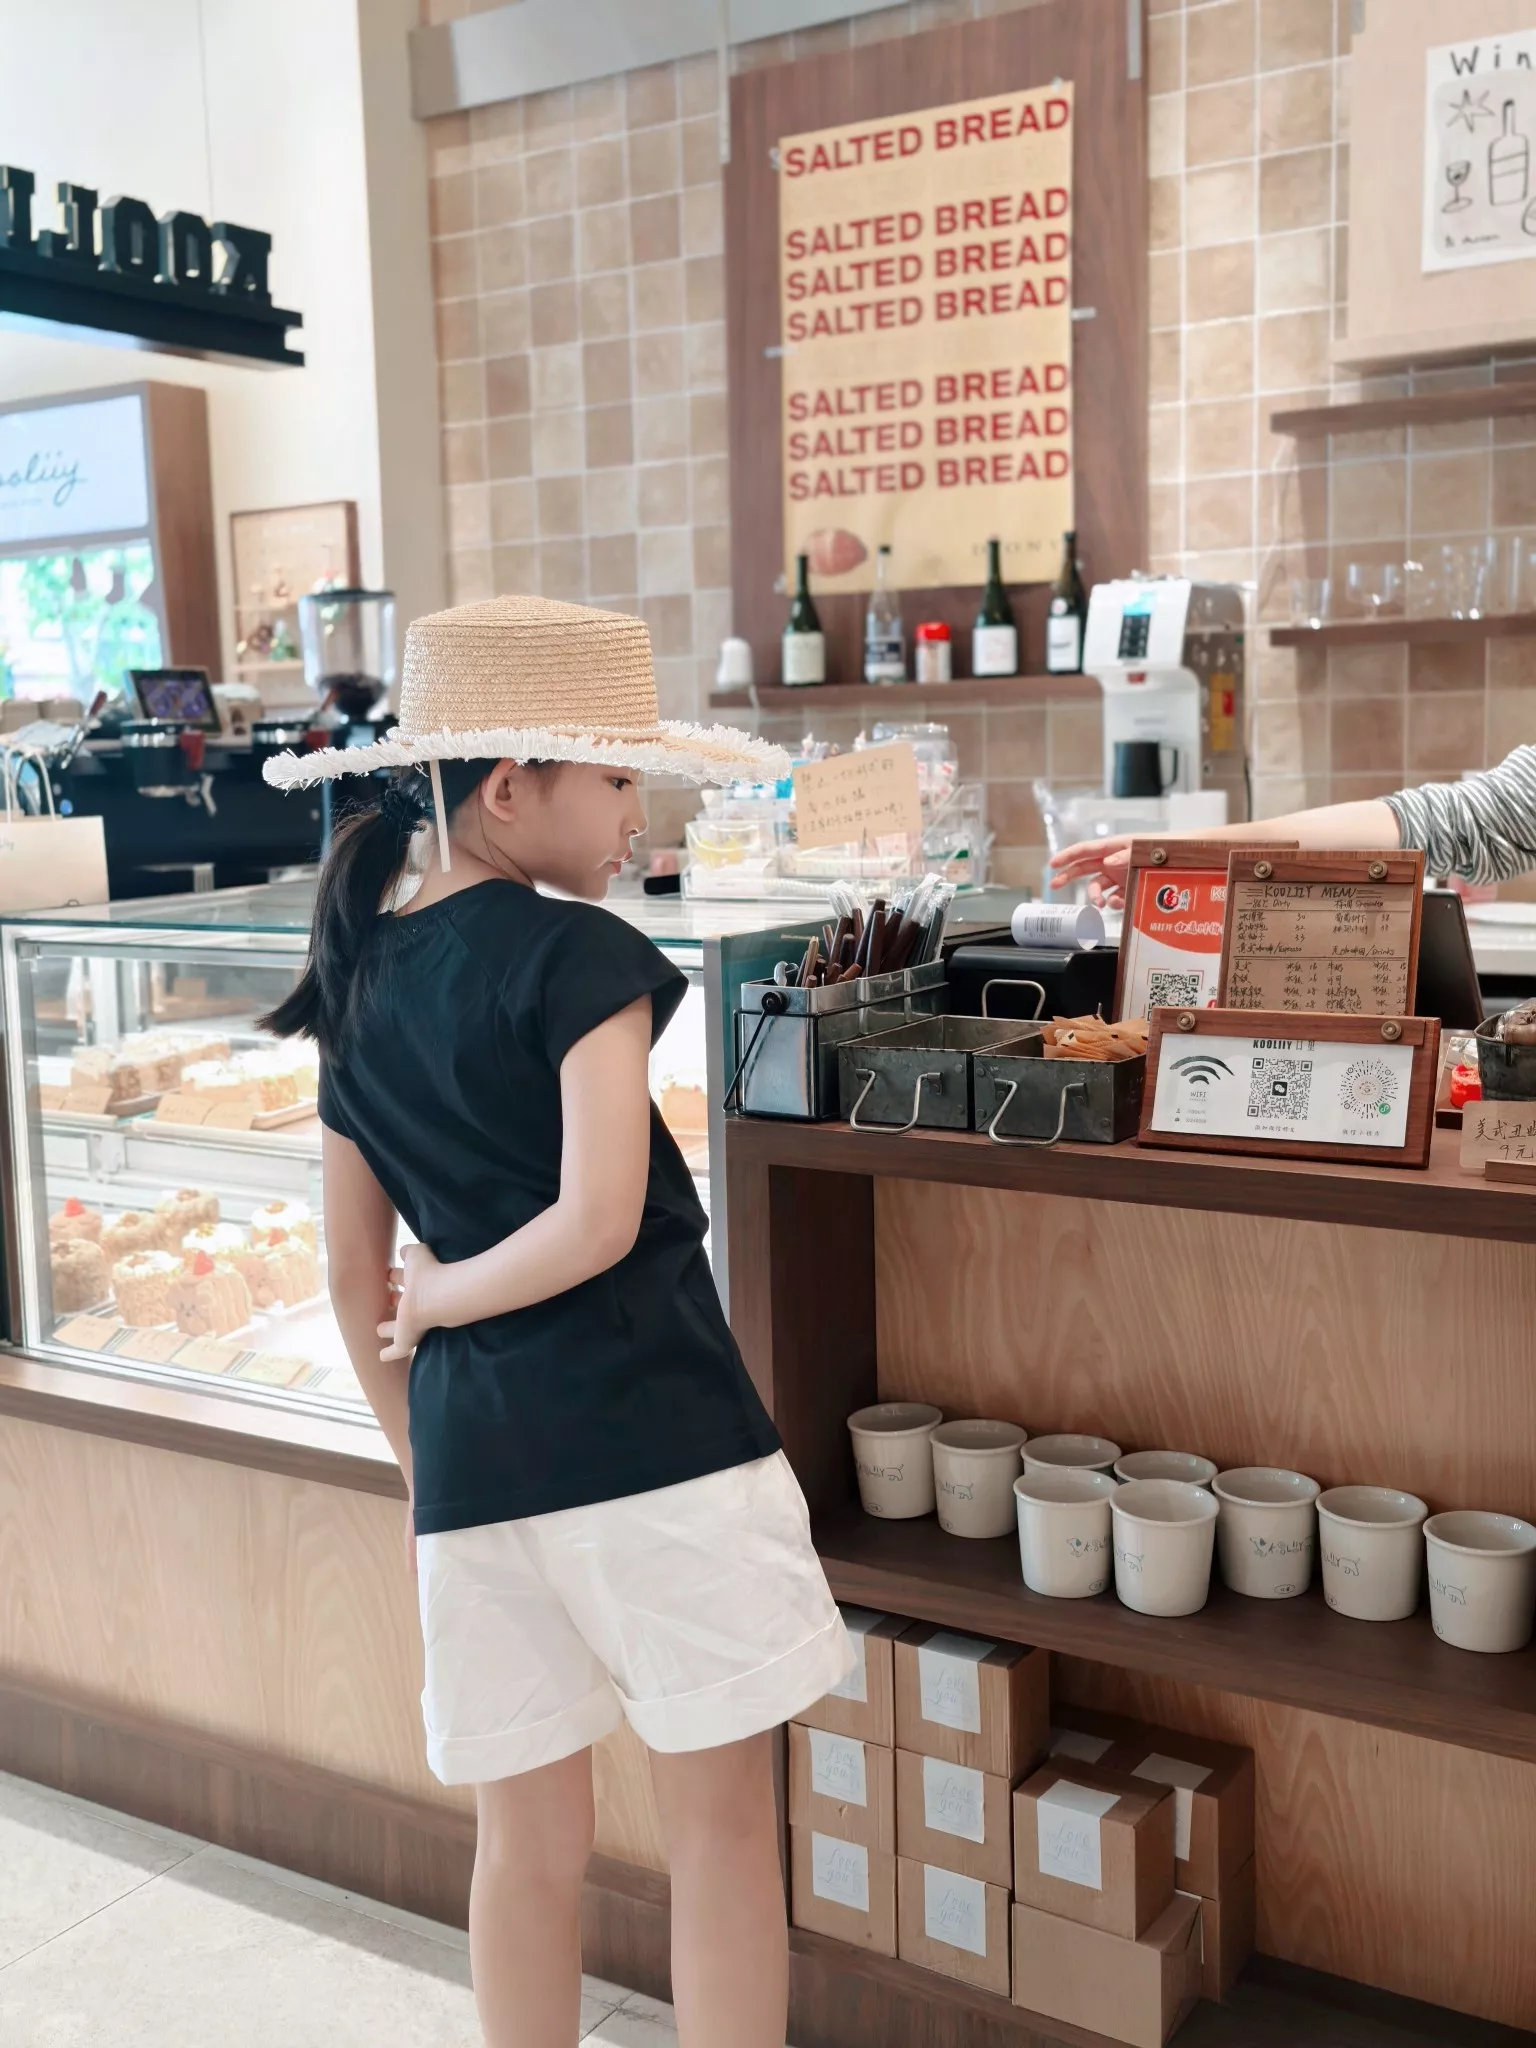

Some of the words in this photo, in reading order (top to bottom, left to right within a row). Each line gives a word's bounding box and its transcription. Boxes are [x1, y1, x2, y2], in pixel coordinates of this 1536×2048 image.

[785, 126, 923, 178] SALTED
[935, 98, 1070, 150] BREAD
[786, 211, 923, 261] SALTED
[935, 187, 1069, 237] BREAD
[786, 254, 923, 301] SALTED
[935, 231, 1069, 279] BREAD
[787, 296, 923, 342] SALTED
[935, 276, 1069, 322] BREAD
[788, 379, 923, 422] SALTED
[935, 363, 1069, 405] BREAD
[788, 422, 924, 461] SALTED
[935, 406, 1069, 447] BREAD
[789, 462, 925, 501] SALTED
[937, 449, 1070, 489] BREAD
[1321, 885, 1358, 898] MENU
[1253, 1039, 1292, 1050] KOOLIIY
